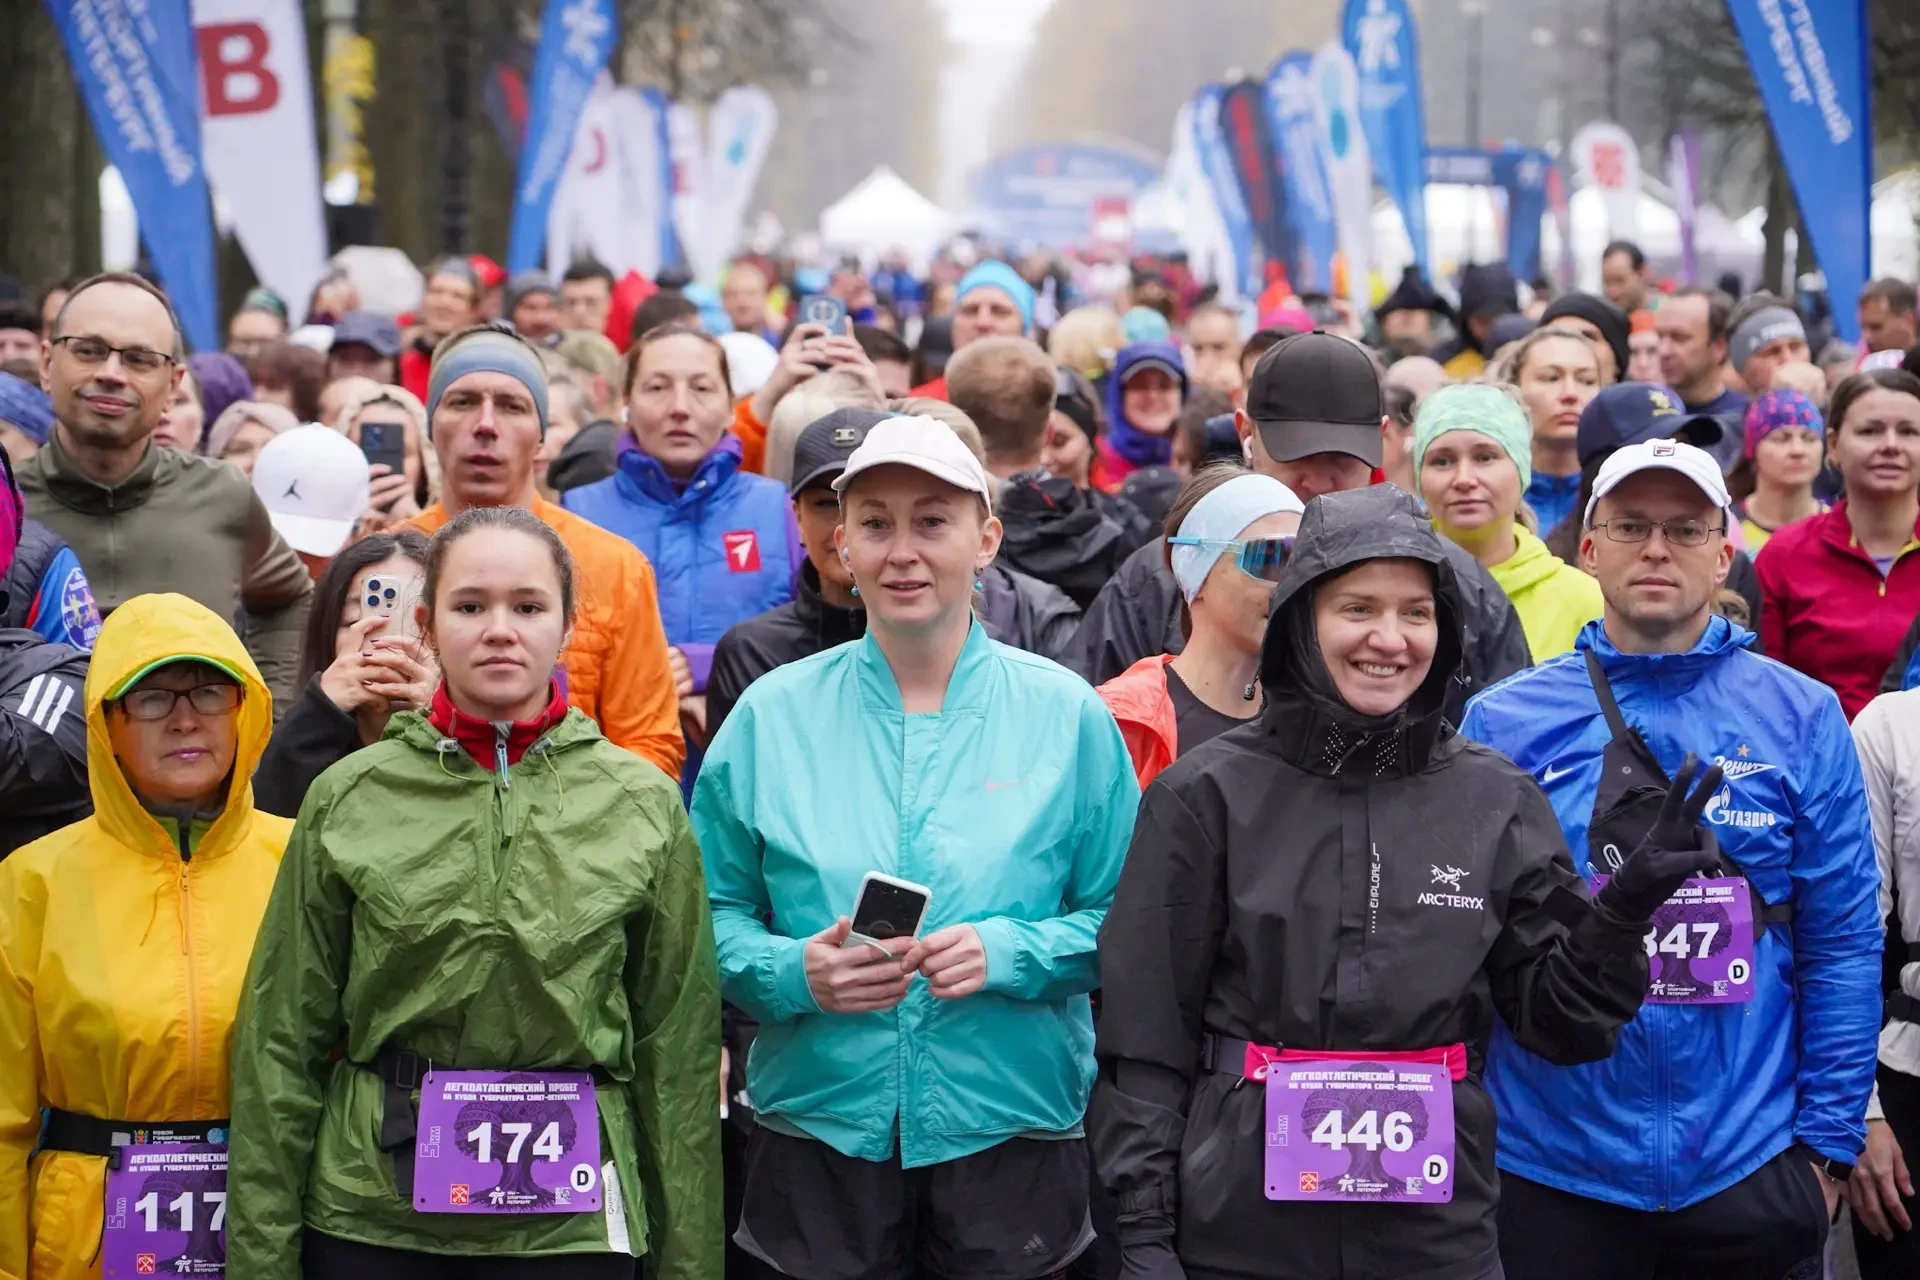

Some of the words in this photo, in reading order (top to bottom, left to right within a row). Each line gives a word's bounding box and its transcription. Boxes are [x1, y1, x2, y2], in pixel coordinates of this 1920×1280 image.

[1706, 887, 1733, 896] ПРОБЕГ
[1733, 965, 1744, 979] D
[1291, 1070, 1395, 1081] ЛЕГКОАТЛЕТИЧЕСКИЙ
[1399, 1073, 1433, 1083] ПРОБЕГ
[444, 1081, 545, 1092] ЛЕГКОАТЛЕТИЧЕСКИЙ
[548, 1083, 578, 1092] ПРОБЕГ
[1312, 1109, 1413, 1152] 446
[468, 1121, 563, 1163] 174
[1429, 1162, 1441, 1177] D
[577, 1170, 589, 1186] D
[135, 1192, 227, 1232] 117
